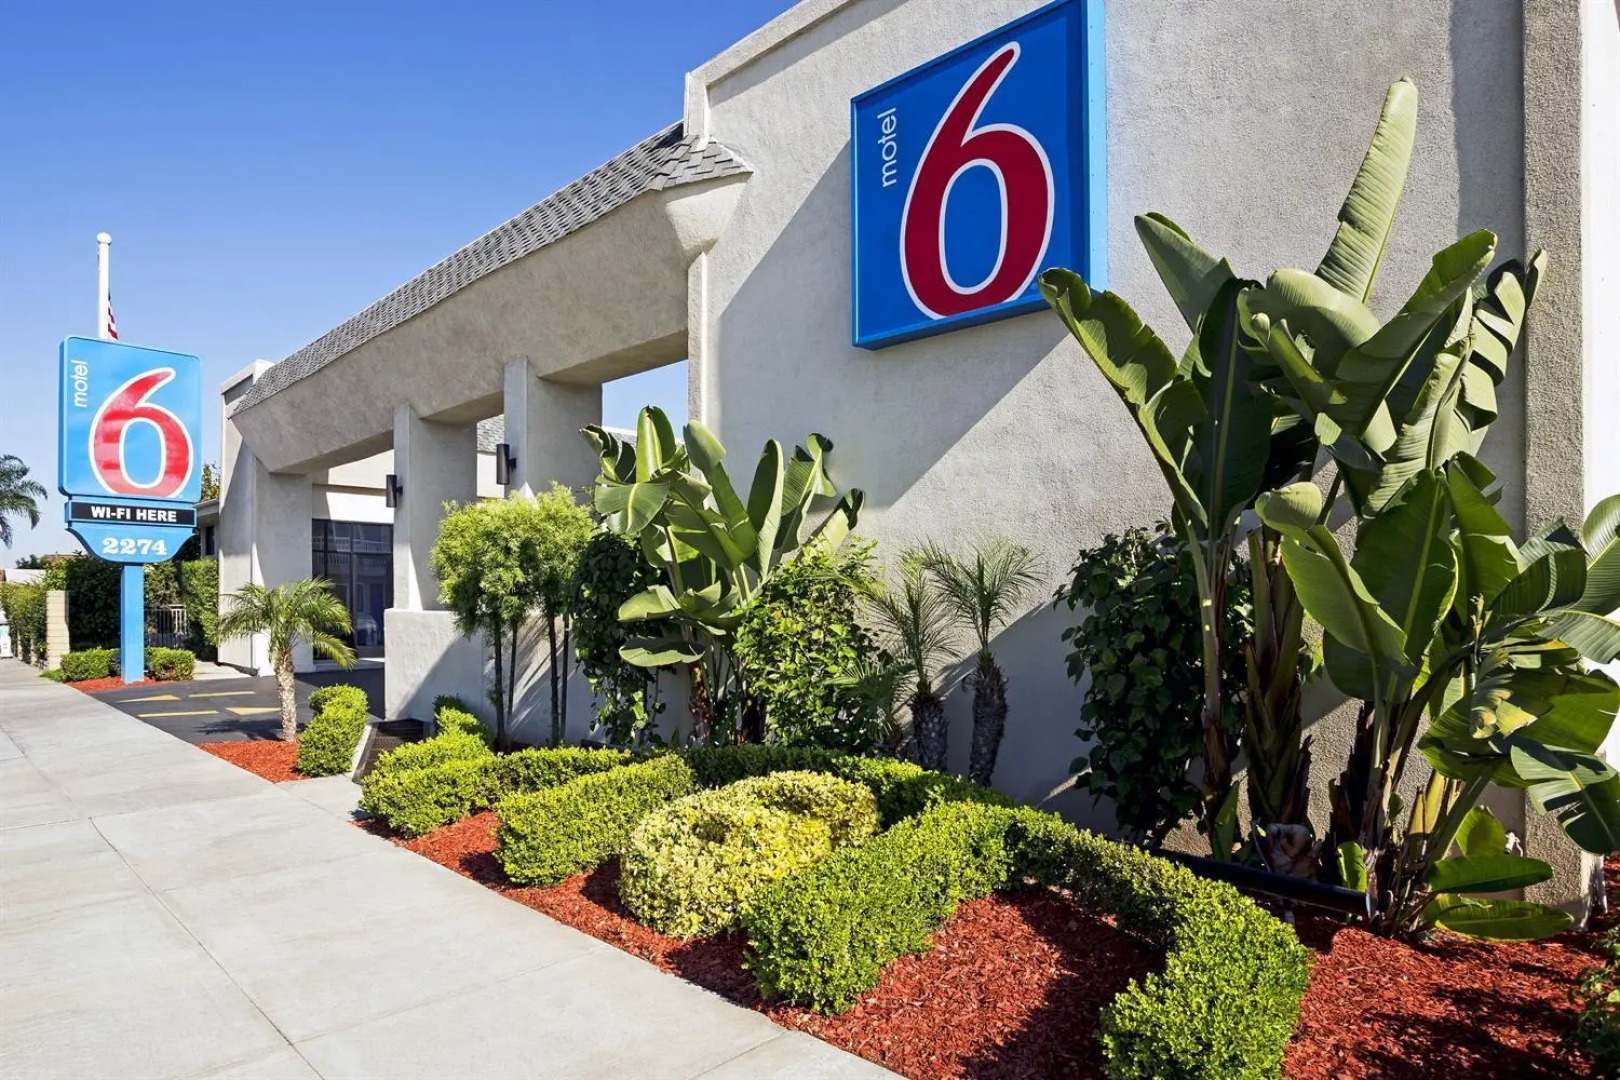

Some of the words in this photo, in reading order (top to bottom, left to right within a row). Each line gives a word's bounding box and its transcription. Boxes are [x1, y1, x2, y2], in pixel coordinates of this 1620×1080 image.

[877, 107, 897, 188] motel
[900, 41, 1055, 320] 6
[72, 360, 88, 408] motel
[88, 367, 194, 498] 6
[90, 505, 131, 520] WI-FI
[136, 508, 177, 523] HERE
[102, 537, 167, 556] 2274
